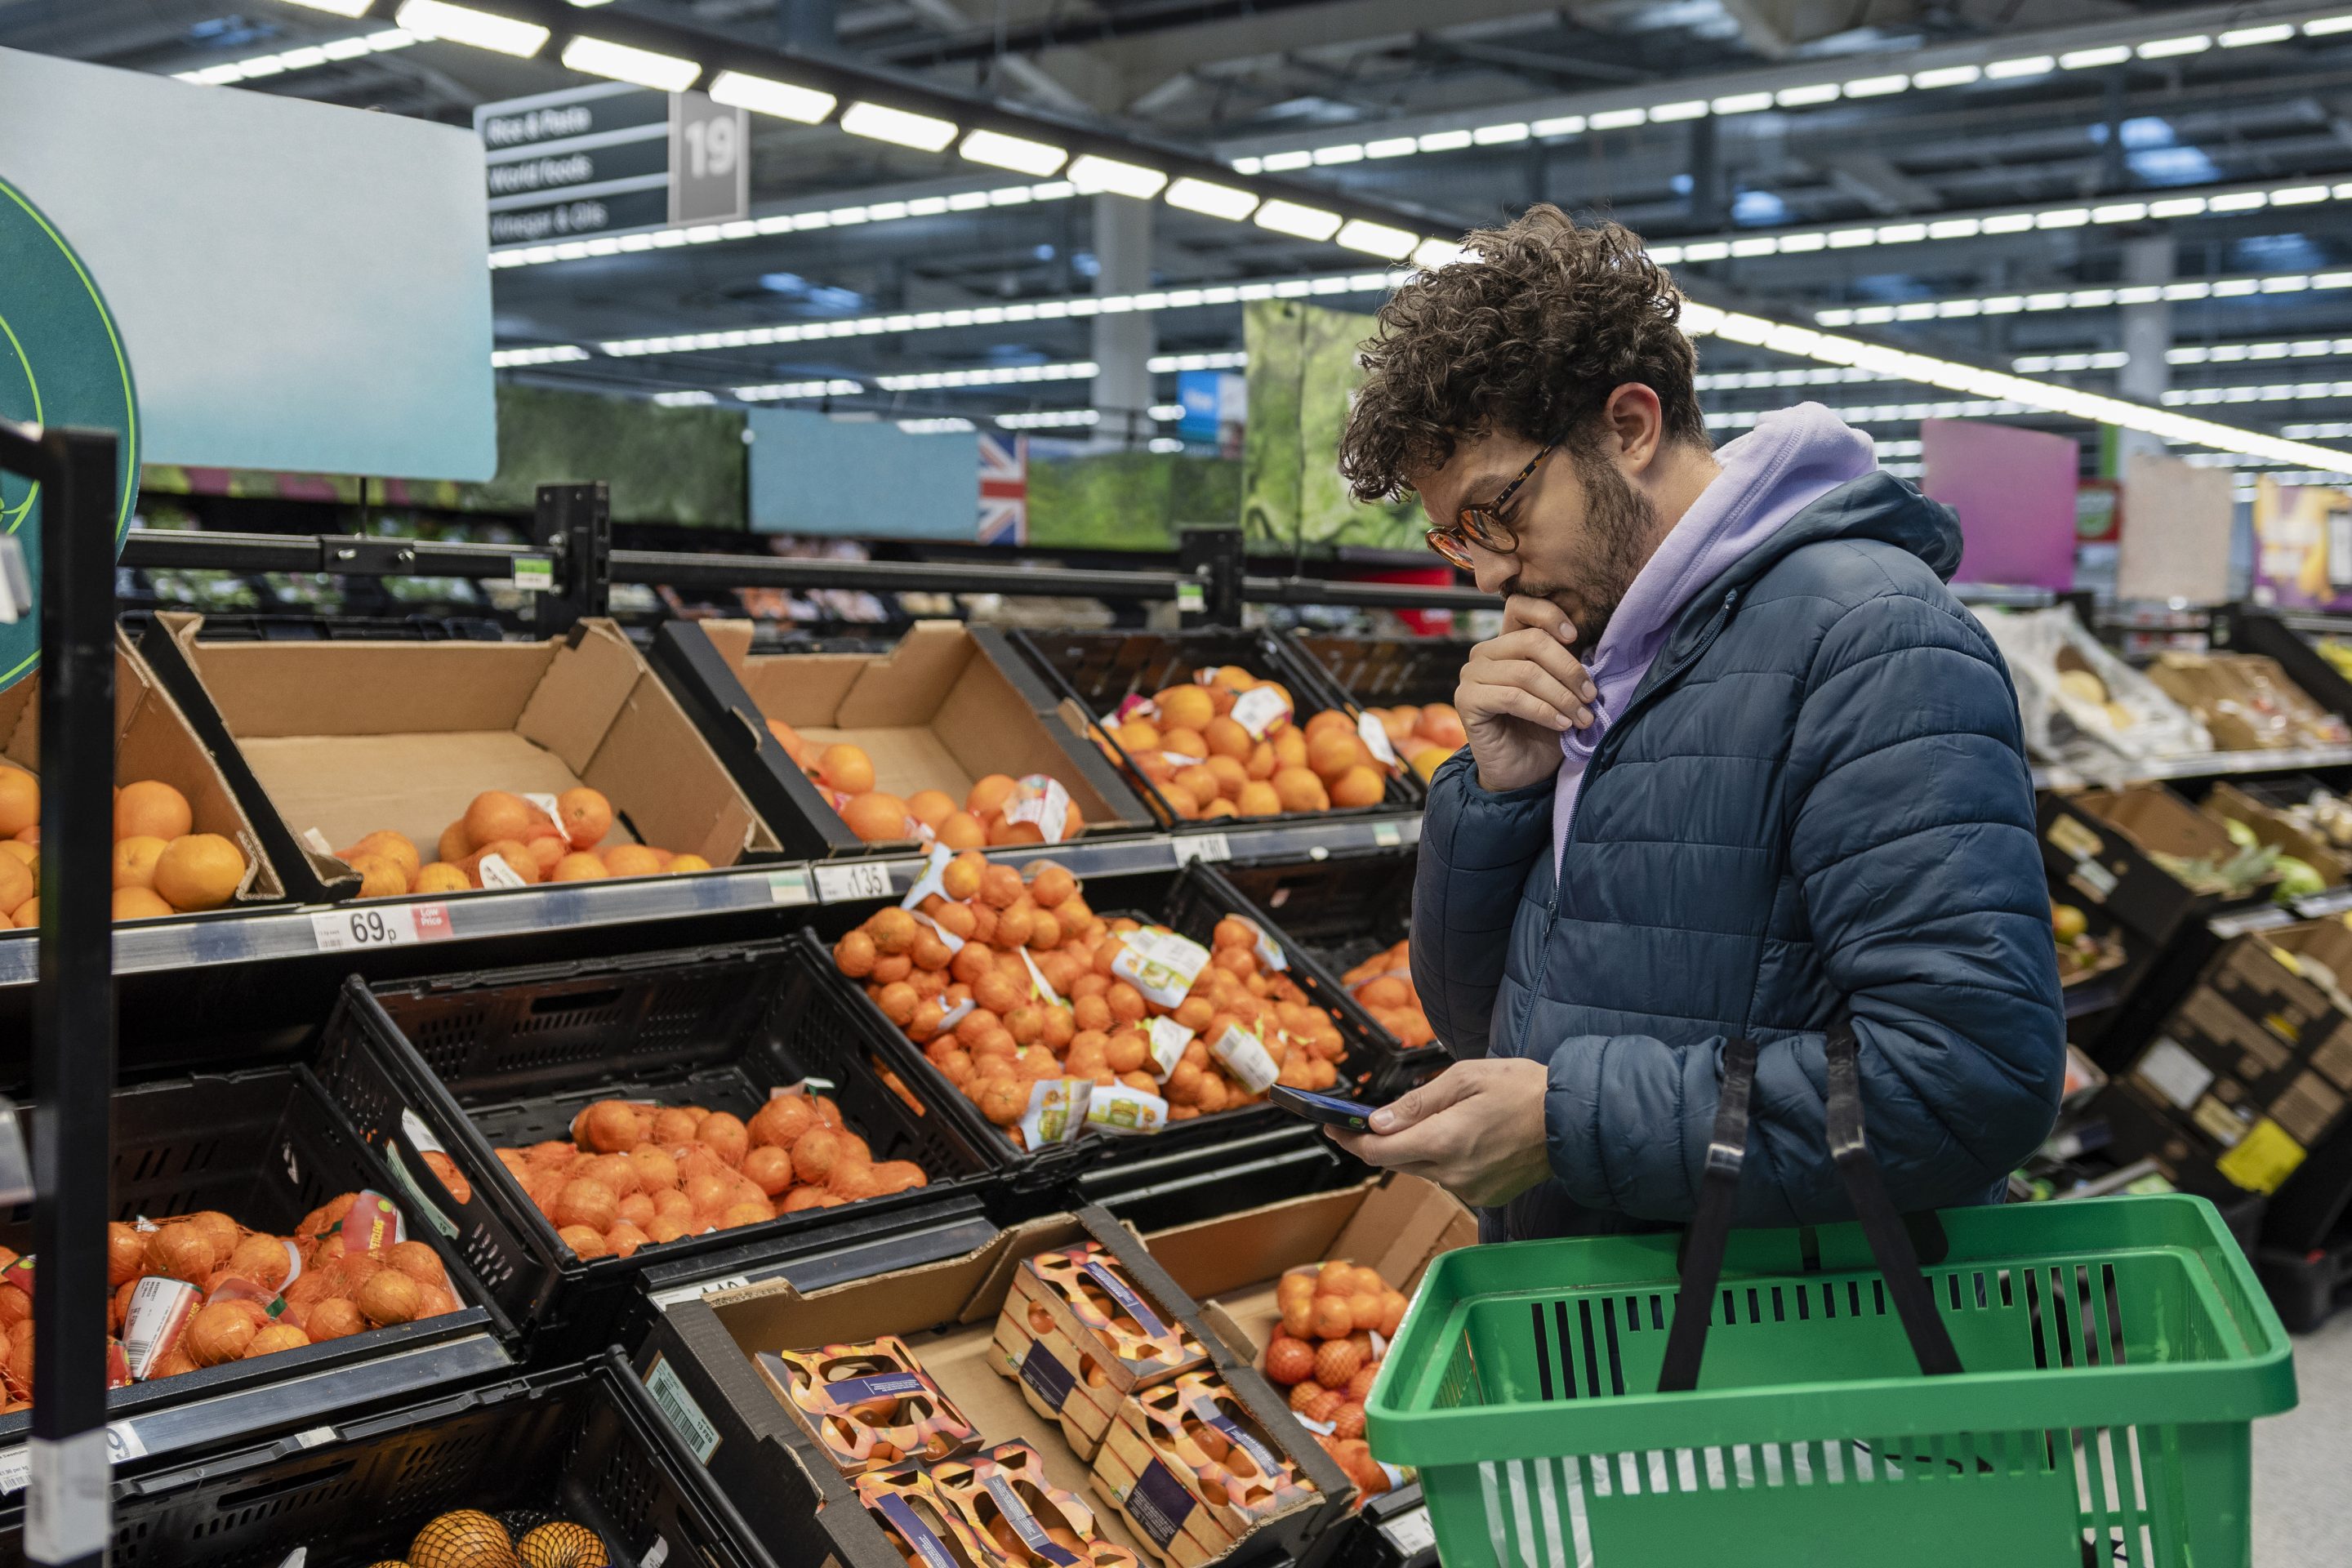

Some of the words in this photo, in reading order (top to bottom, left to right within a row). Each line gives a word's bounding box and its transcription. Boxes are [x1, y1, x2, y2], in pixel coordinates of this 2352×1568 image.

[684, 116, 736, 178] 19
[420, 907, 439, 916] Low
[421, 916, 443, 926] Price
[702, 1429, 713, 1444] FEB
